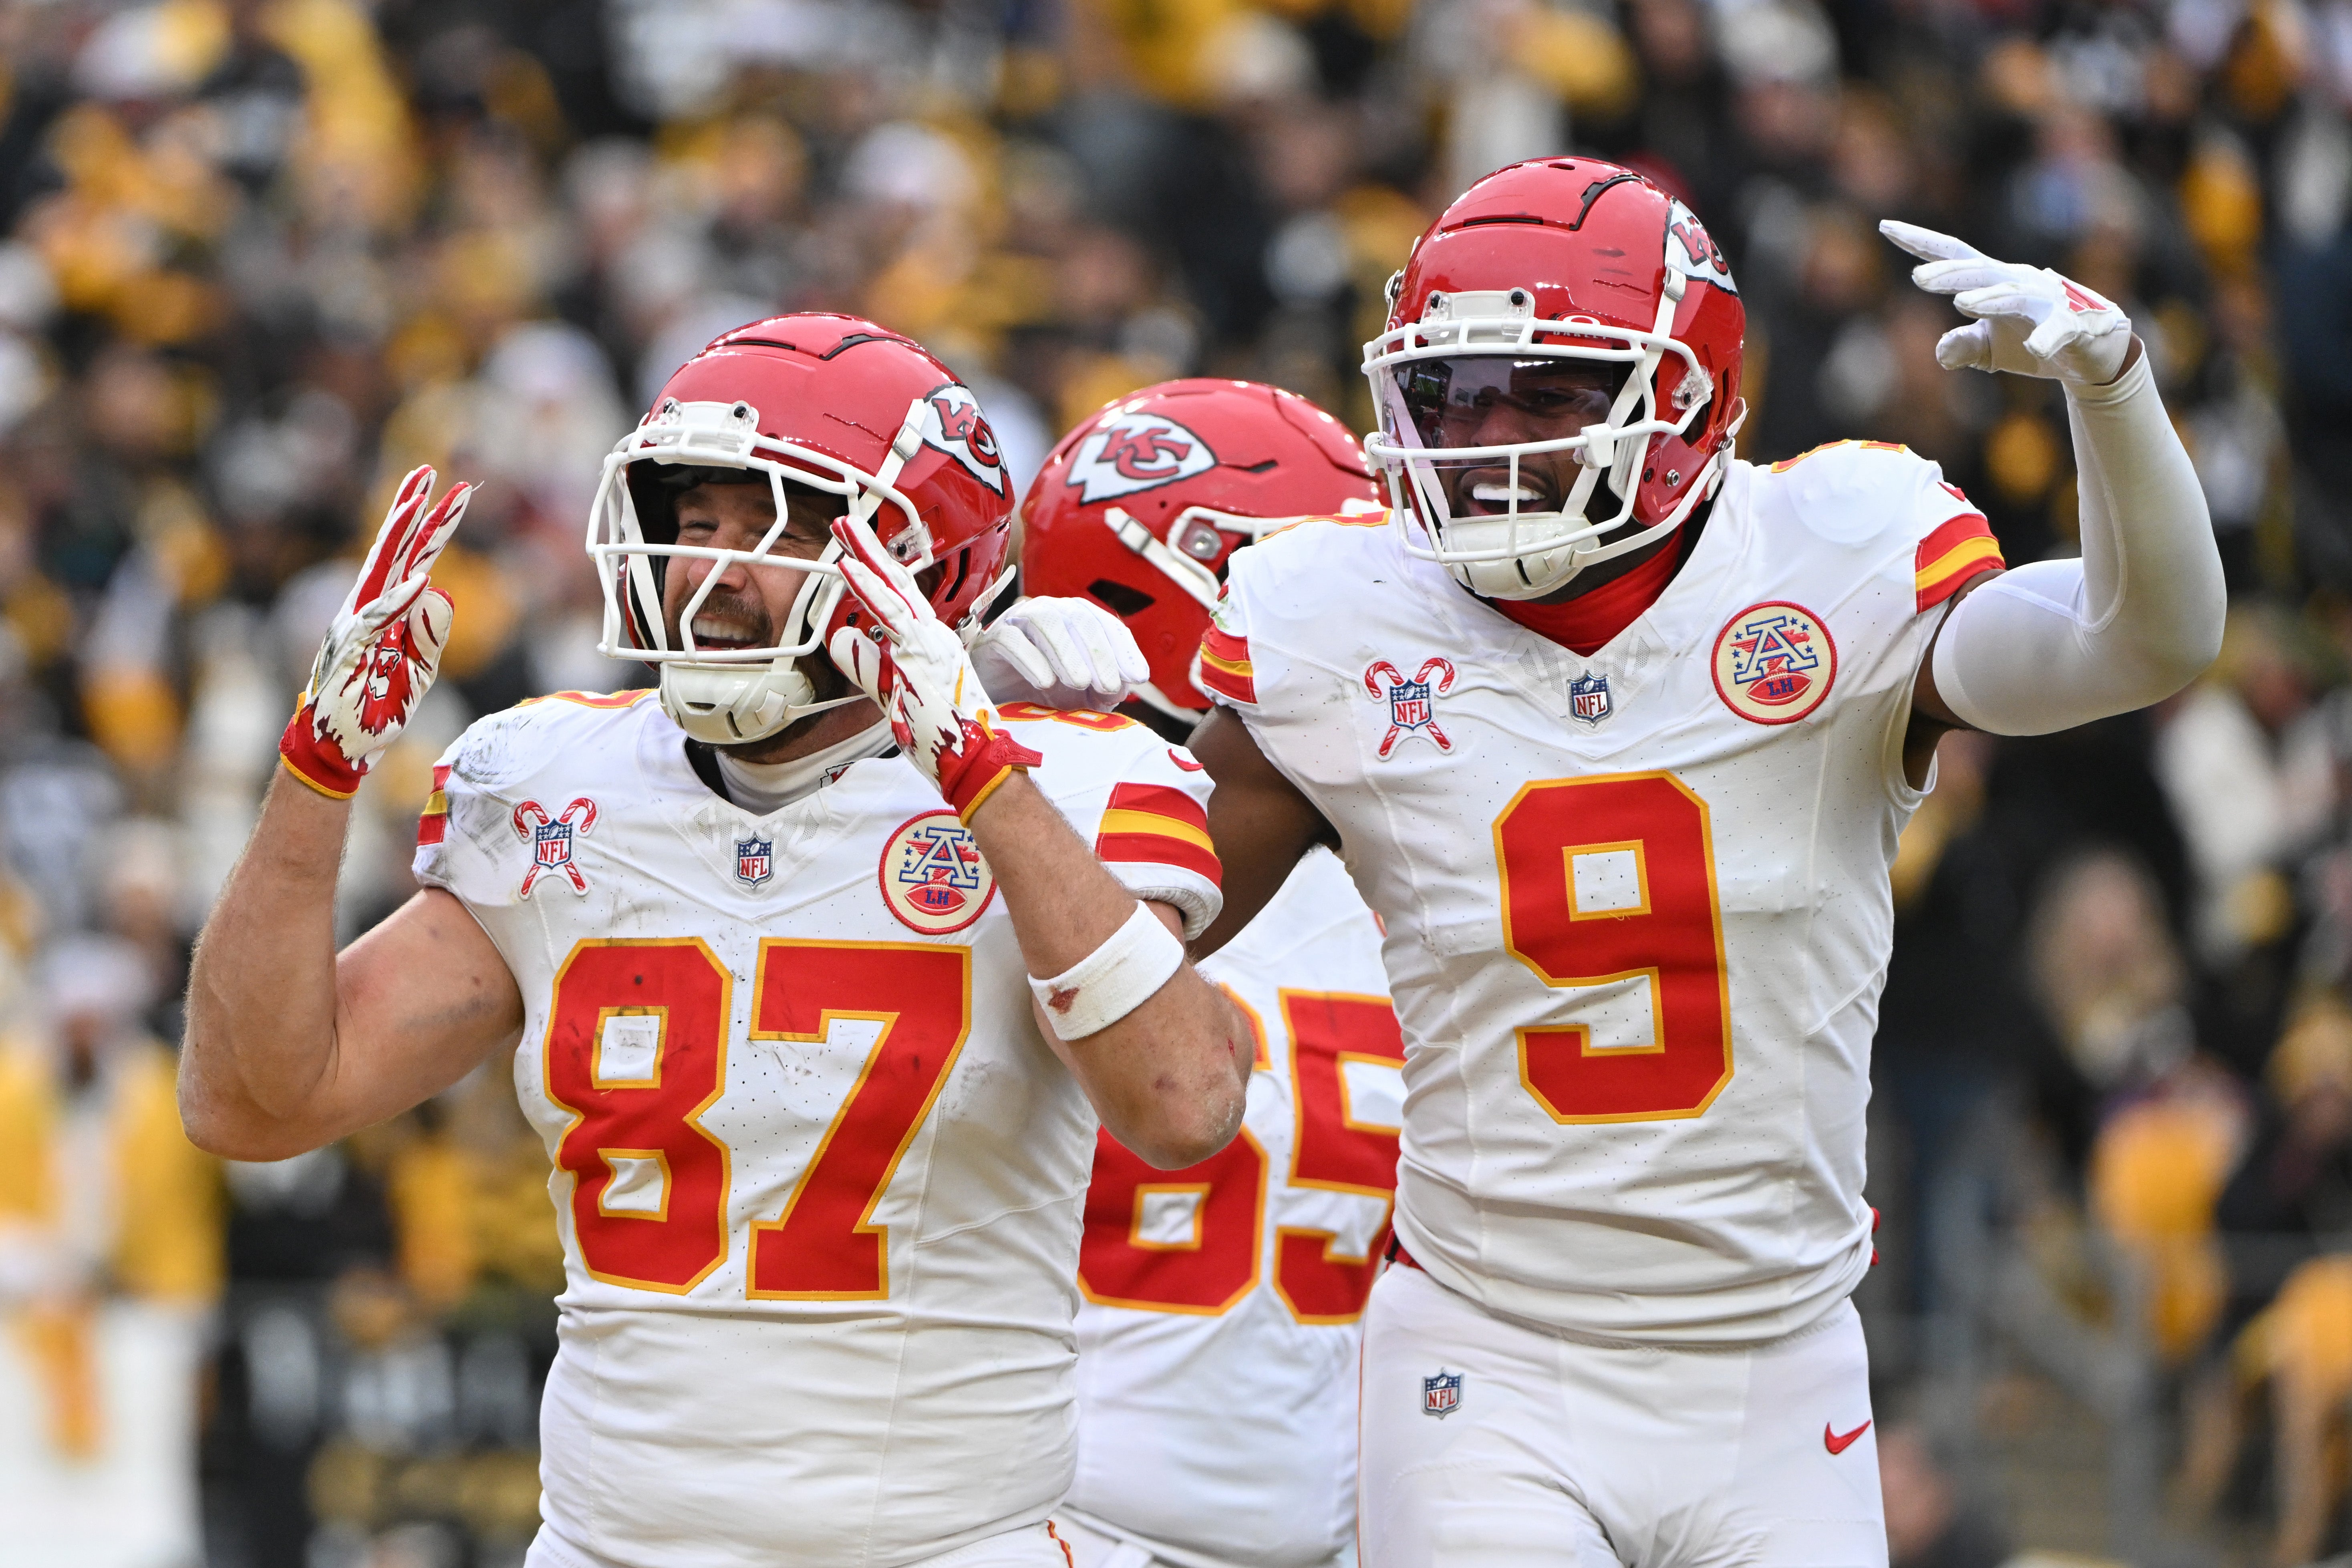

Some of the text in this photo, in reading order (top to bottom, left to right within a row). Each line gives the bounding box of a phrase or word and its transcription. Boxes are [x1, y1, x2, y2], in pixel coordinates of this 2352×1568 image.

[932, 398, 1000, 467] KC
[1095, 427, 1191, 479] KC
[1734, 615, 1818, 684] A
[376, 655, 396, 678] K
[1766, 678, 1794, 696] LH
[1395, 700, 1428, 724] NFL
[1576, 696, 1606, 715] NFL
[538, 840, 568, 864] NFL
[899, 827, 979, 889] A
[740, 857, 767, 881] NFL
[925, 890, 950, 905] LH
[1492, 769, 1734, 1124] 9
[543, 936, 971, 1300] 87
[1428, 1389, 1455, 1408] NFL
